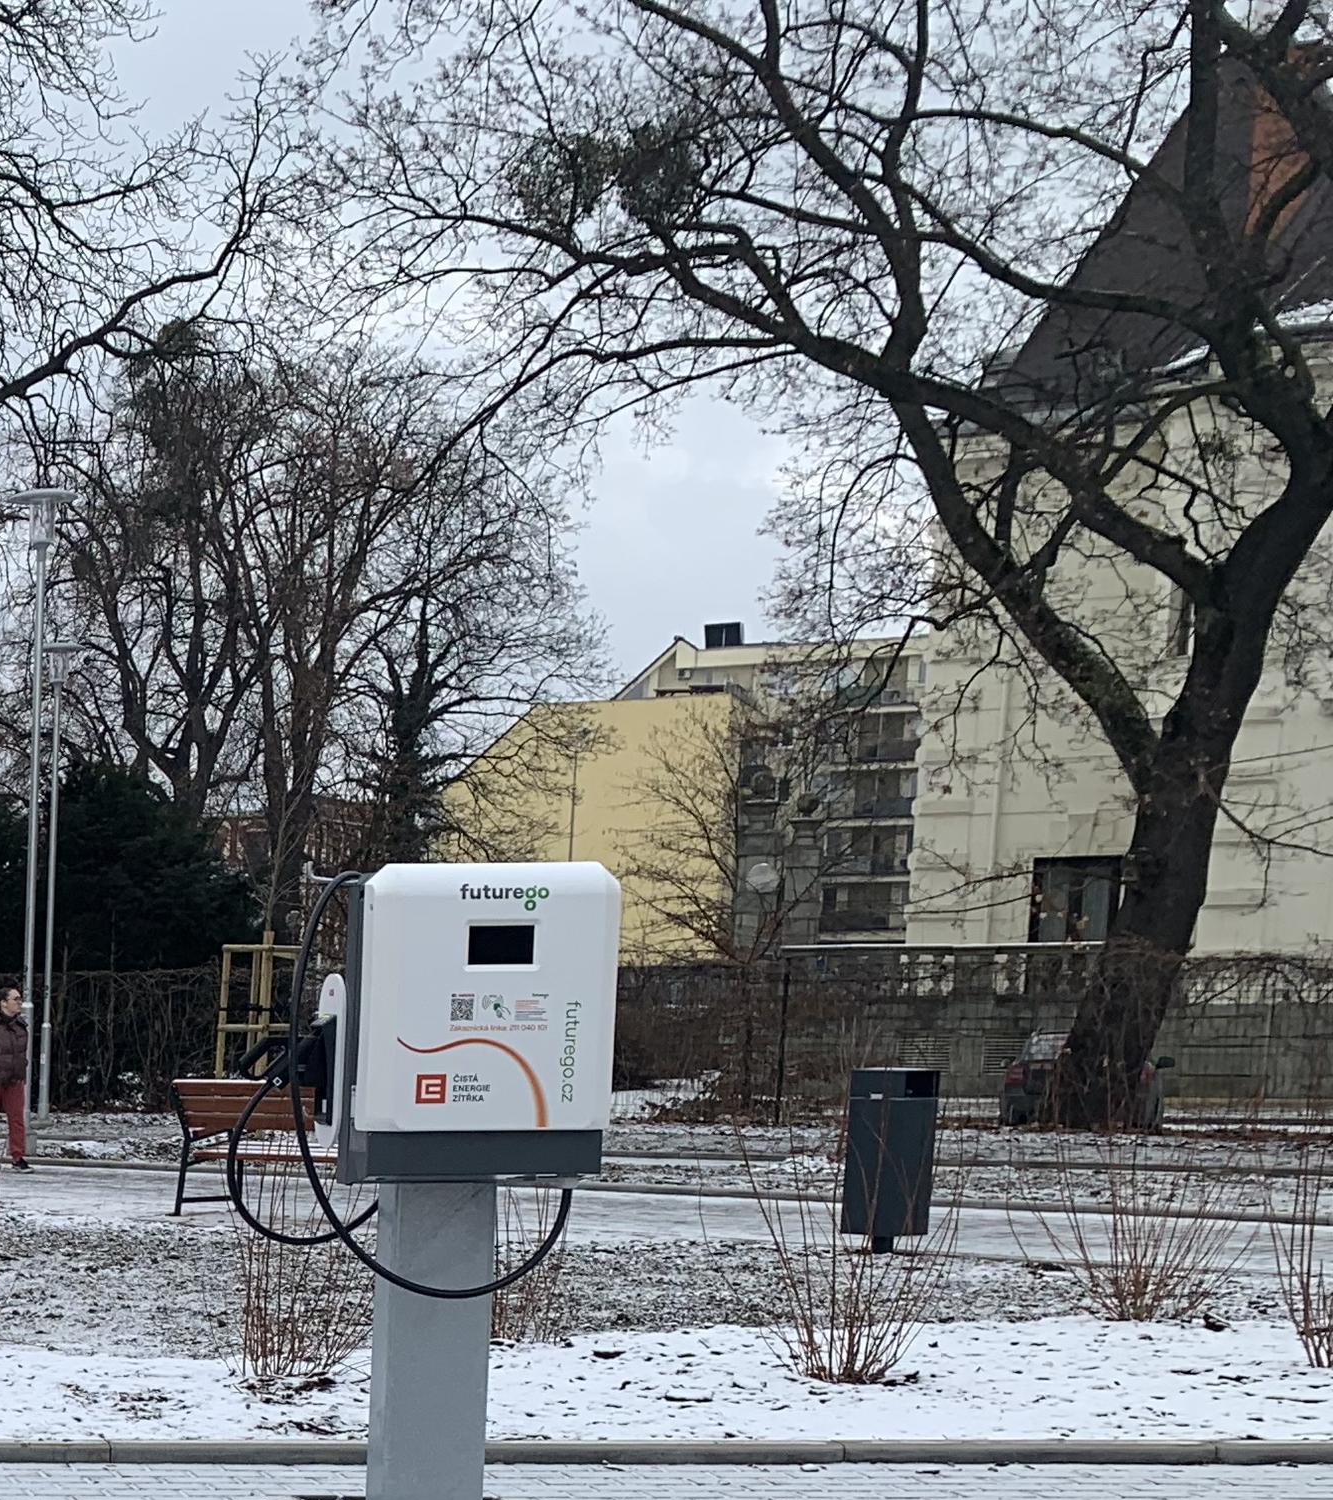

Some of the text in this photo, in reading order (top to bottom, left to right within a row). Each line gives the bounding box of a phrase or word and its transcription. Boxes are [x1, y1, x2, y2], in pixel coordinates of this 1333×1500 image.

[460, 884, 549, 911] futurego
[559, 1000, 582, 1103] futurego.cz
[453, 1073, 478, 1082] ČISTÁ
[453, 1084, 490, 1092] ENERGIE
[452, 1092, 484, 1102] ZÍTŘKA
